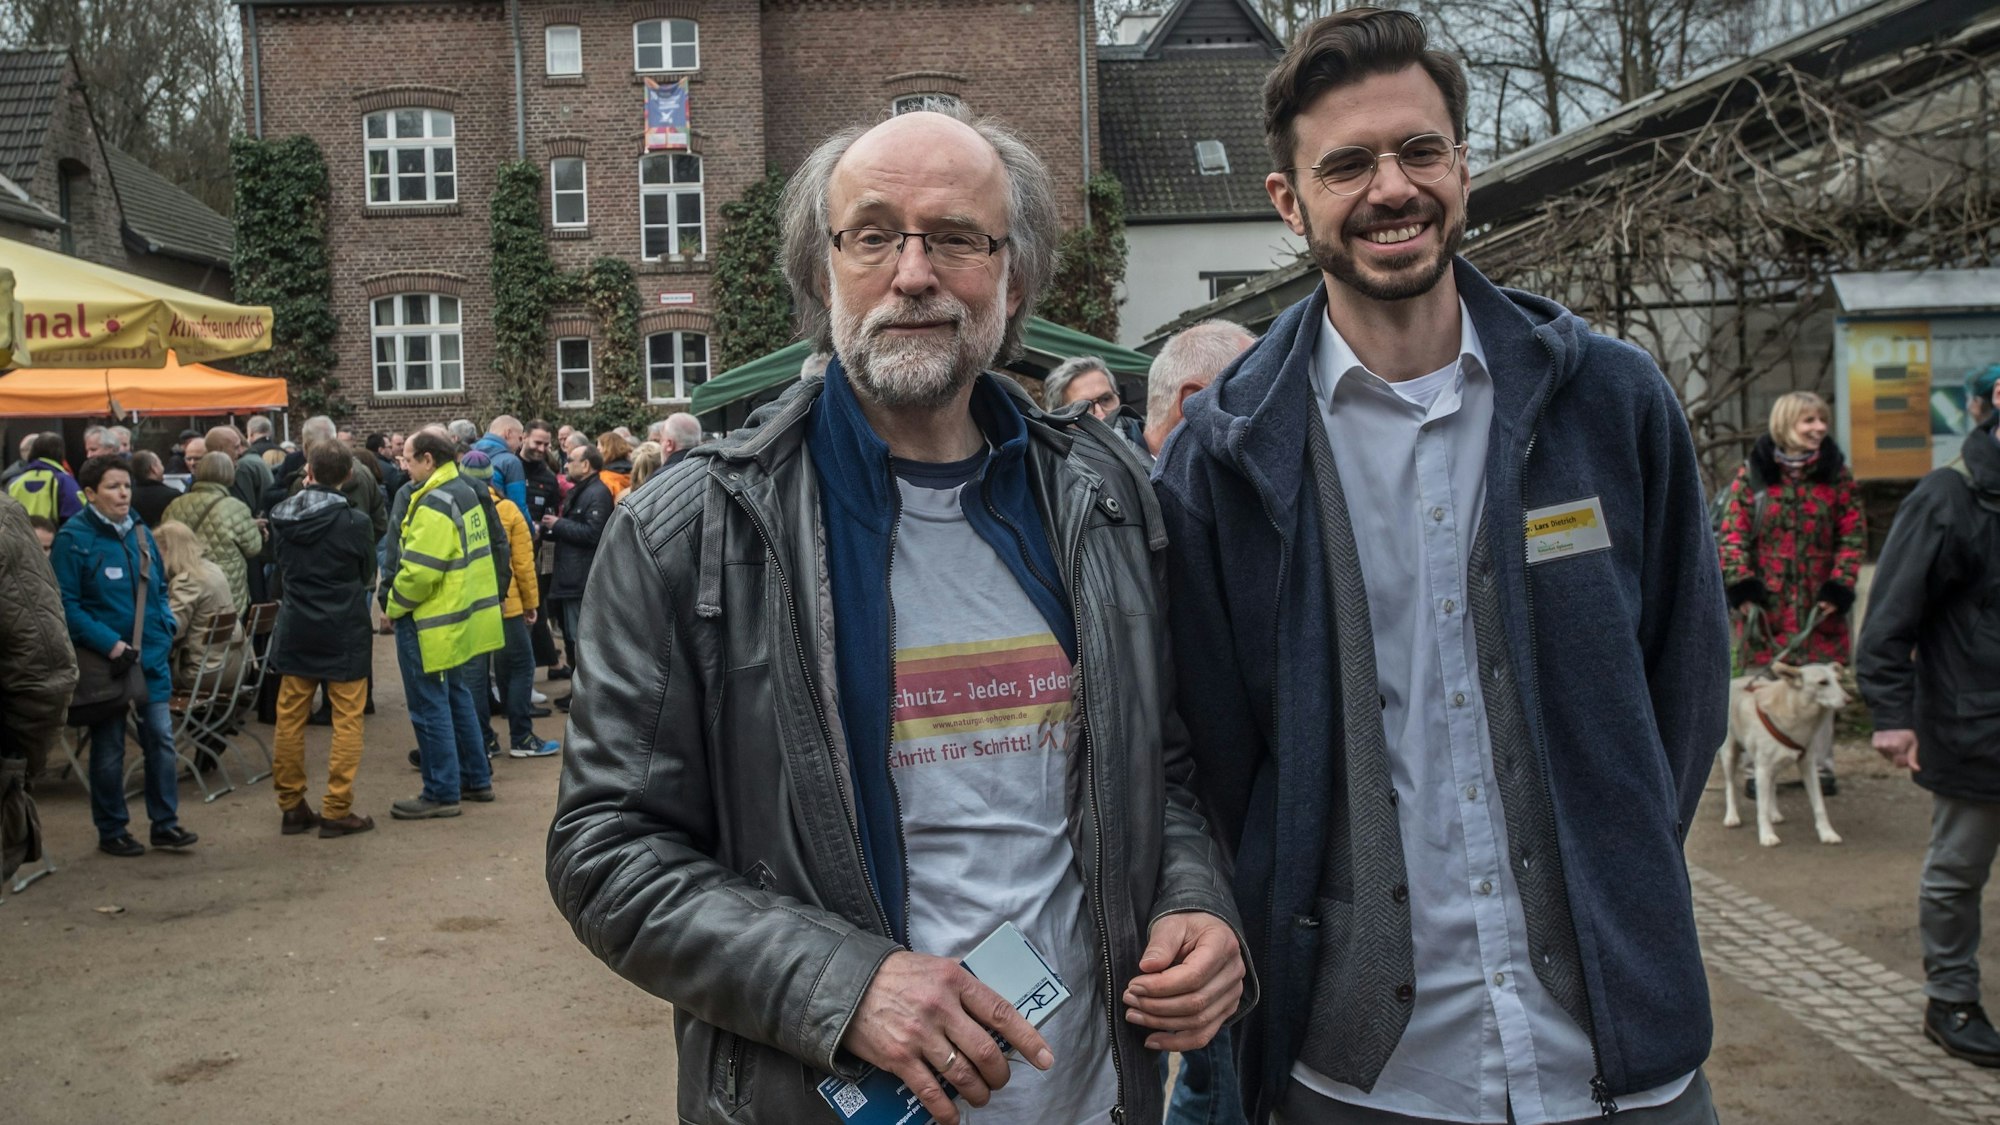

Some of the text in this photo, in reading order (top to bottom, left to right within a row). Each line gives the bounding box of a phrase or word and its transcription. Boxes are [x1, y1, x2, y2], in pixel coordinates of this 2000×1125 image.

[25, 303, 91, 338] nal
[1534, 523, 1549, 531] Lars
[1550, 516, 1577, 527] Dietrich
[967, 678, 1022, 700] Jeder,
[941, 743, 967, 761] für
[973, 734, 1031, 757] Schritt!
